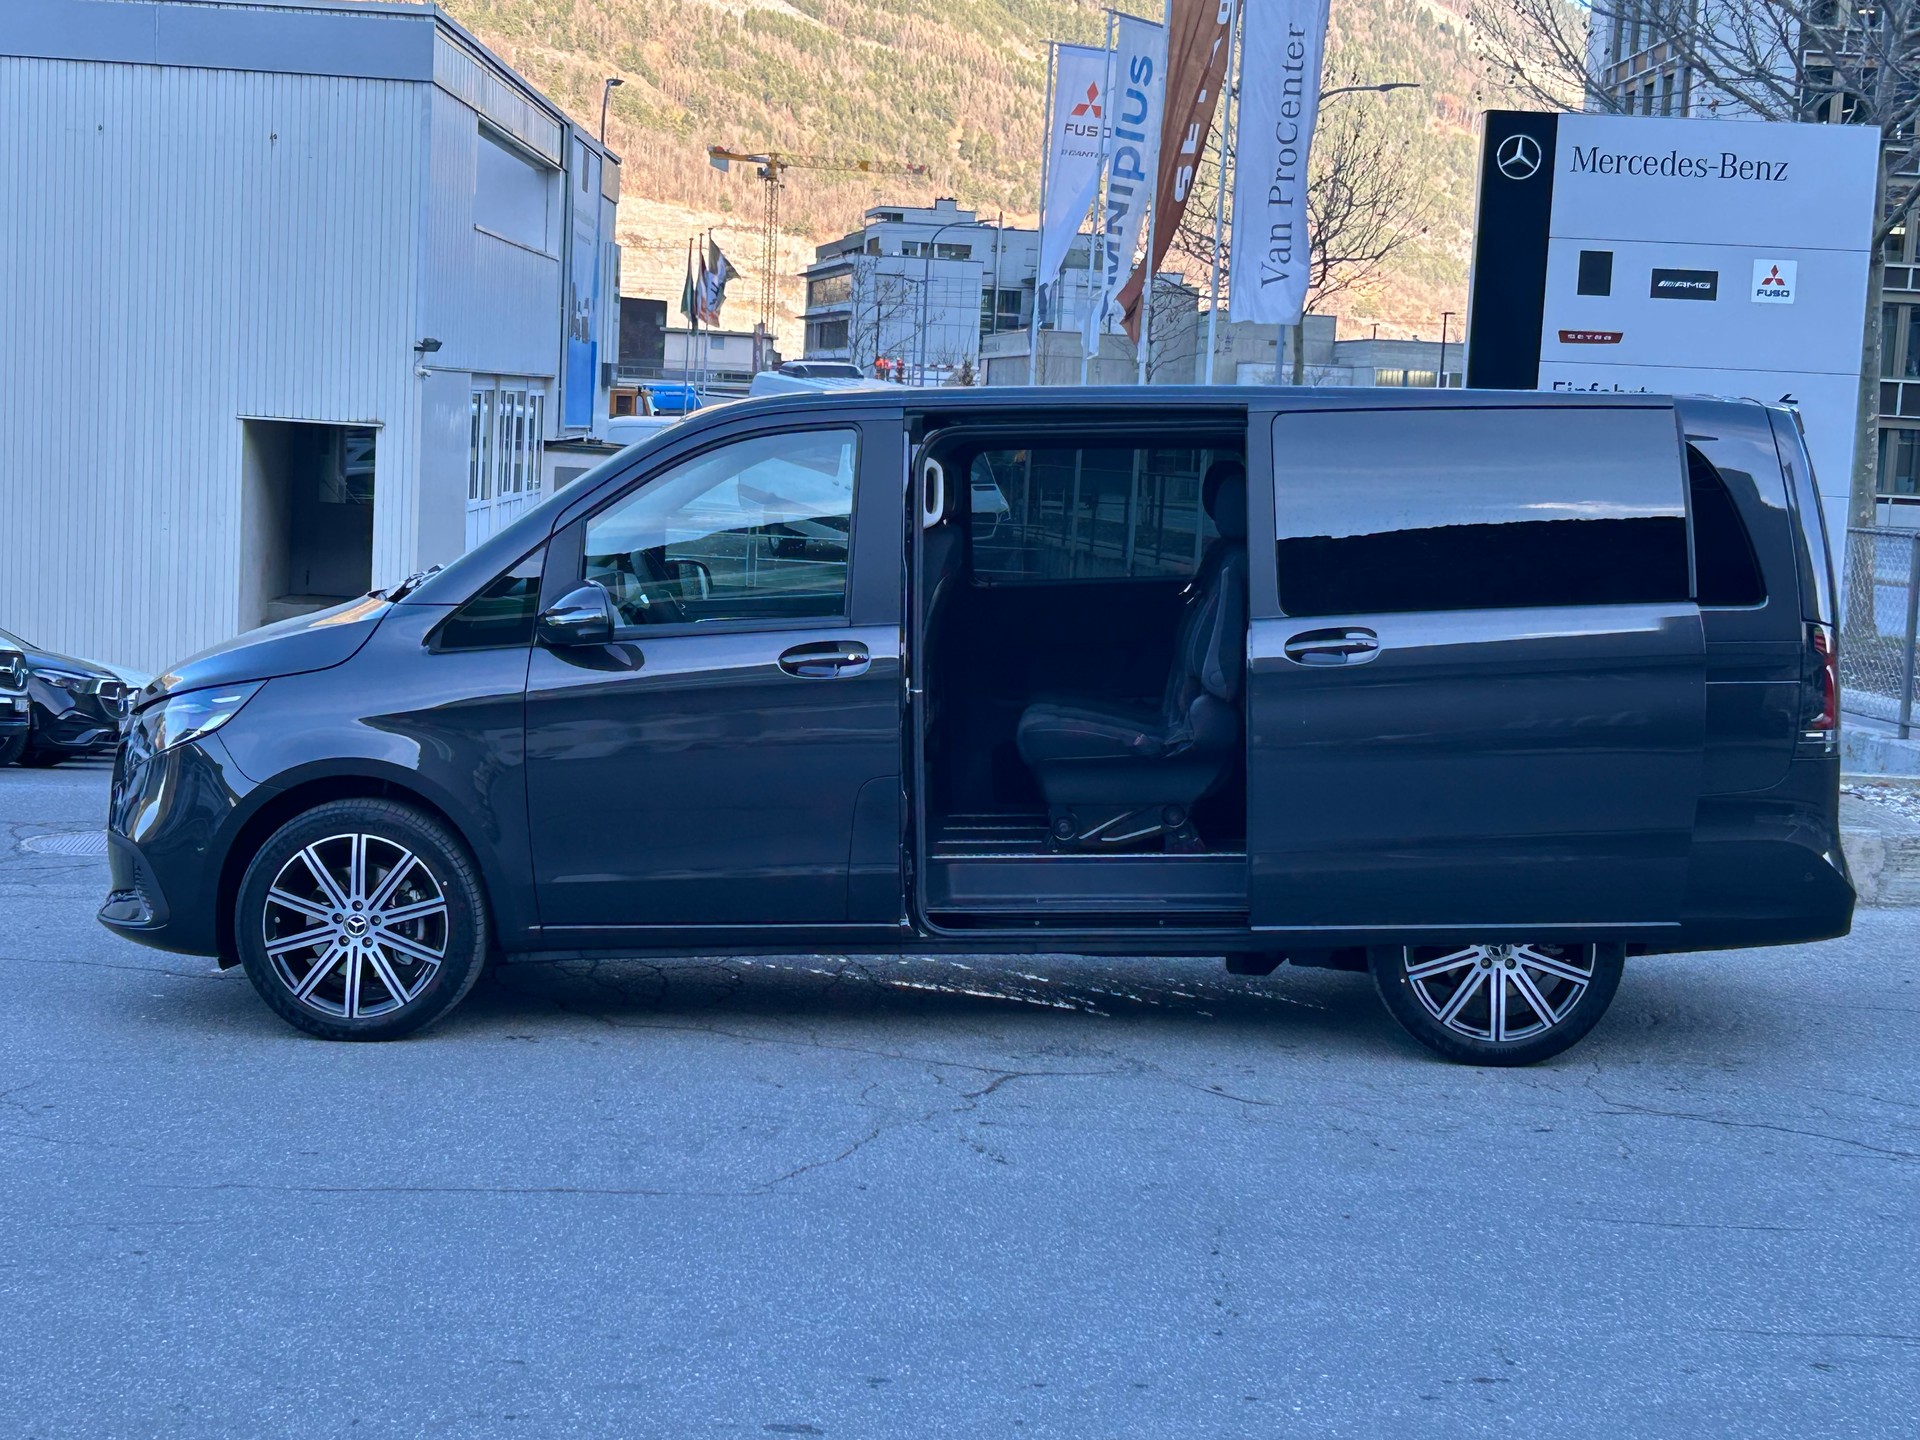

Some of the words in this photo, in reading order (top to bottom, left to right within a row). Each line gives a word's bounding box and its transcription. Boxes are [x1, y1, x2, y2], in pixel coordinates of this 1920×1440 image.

[1267, 24, 1306, 208] ProCenter
[1569, 145, 1790, 183] Mercedes-Benz
[1261, 222, 1293, 289] Van
[1756, 289, 1790, 298] FUSO
